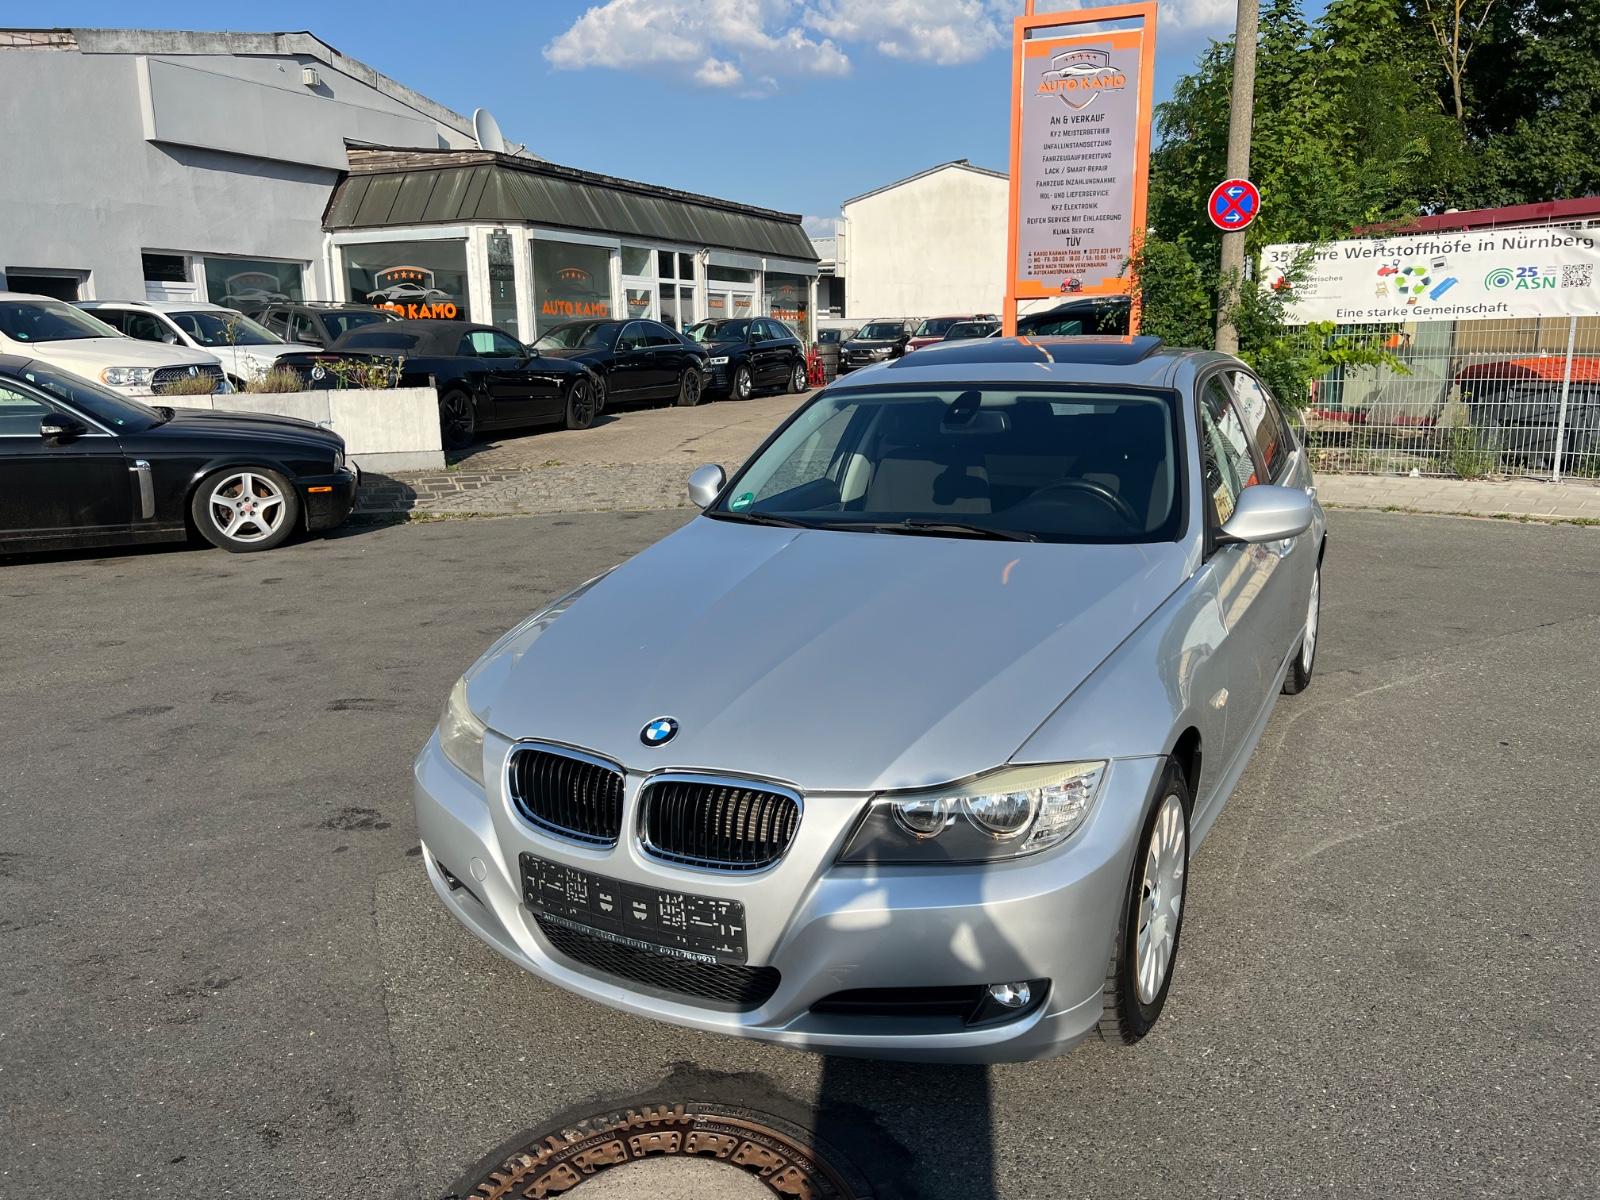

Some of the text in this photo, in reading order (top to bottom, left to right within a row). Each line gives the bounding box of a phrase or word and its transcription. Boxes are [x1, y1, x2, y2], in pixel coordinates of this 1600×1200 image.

[1038, 74, 1126, 92] AUTO KAMO
[1063, 116, 1068, 124] &
[1071, 114, 1106, 124] VERKAUF
[1063, 128, 1110, 137] MEISTERBETRIEB
[1043, 140, 1112, 150] UNFALLINSTANDSETZUNG
[1042, 152, 1112, 163] FAHRZEUGAUFBEREITUNG
[1044, 166, 1060, 174] LACK
[1036, 177, 1116, 188] FAHRZEUG INZAHLUNGNAHME
[1066, 190, 1110, 198] LIEFERSERVICE
[1083, 214, 1122, 222] EINLAGERUNG
[1066, 235, 1081, 247] TÜV
[1270, 251, 1288, 262] 35
[1344, 240, 1471, 260] Wertstoffhöfe
[1478, 237, 1495, 251] in
[1502, 234, 1594, 250] Nürnberg
[1516, 266, 1538, 278] 25
[1515, 276, 1556, 290] ASN
[408, 303, 457, 319] KAMO
[542, 300, 608, 317] AUTO KAMO
[1336, 302, 1509, 319] Eine starke Gemeinschaft
